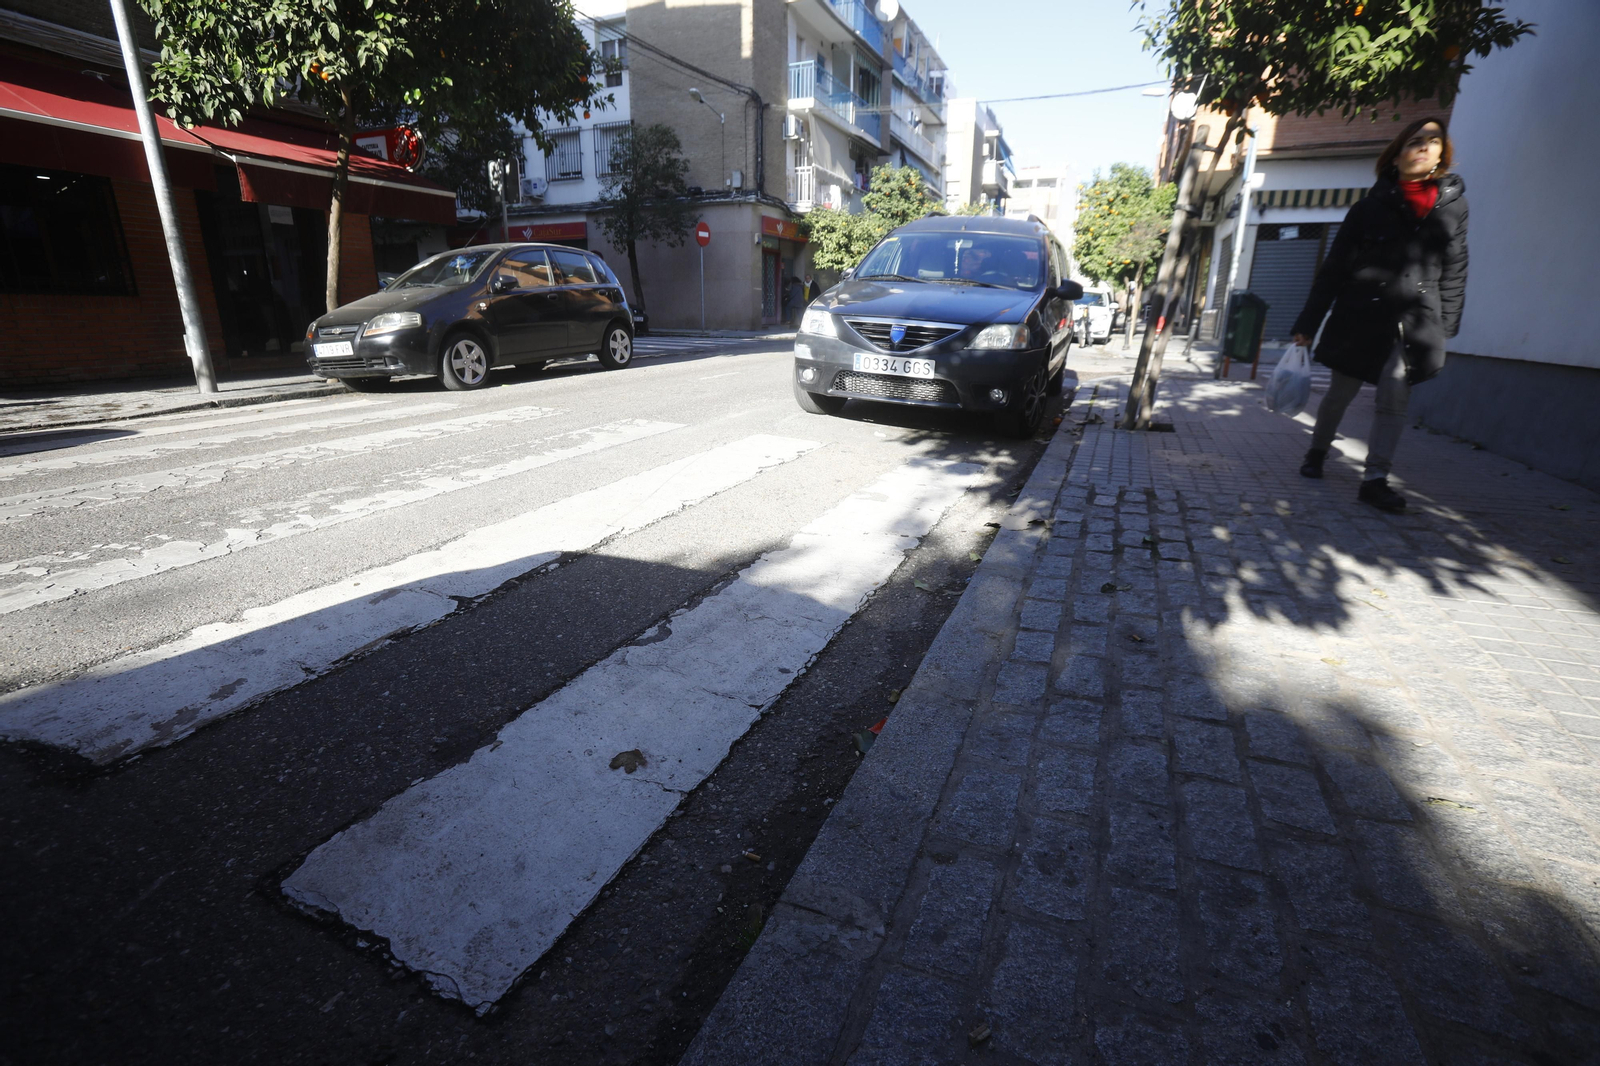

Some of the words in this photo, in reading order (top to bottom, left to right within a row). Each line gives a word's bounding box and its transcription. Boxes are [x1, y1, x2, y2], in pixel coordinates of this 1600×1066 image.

[533, 228, 562, 237] CajaSur
[335, 343, 351, 353] FVR
[863, 357, 898, 373] 0334
[903, 360, 931, 376] GGS
